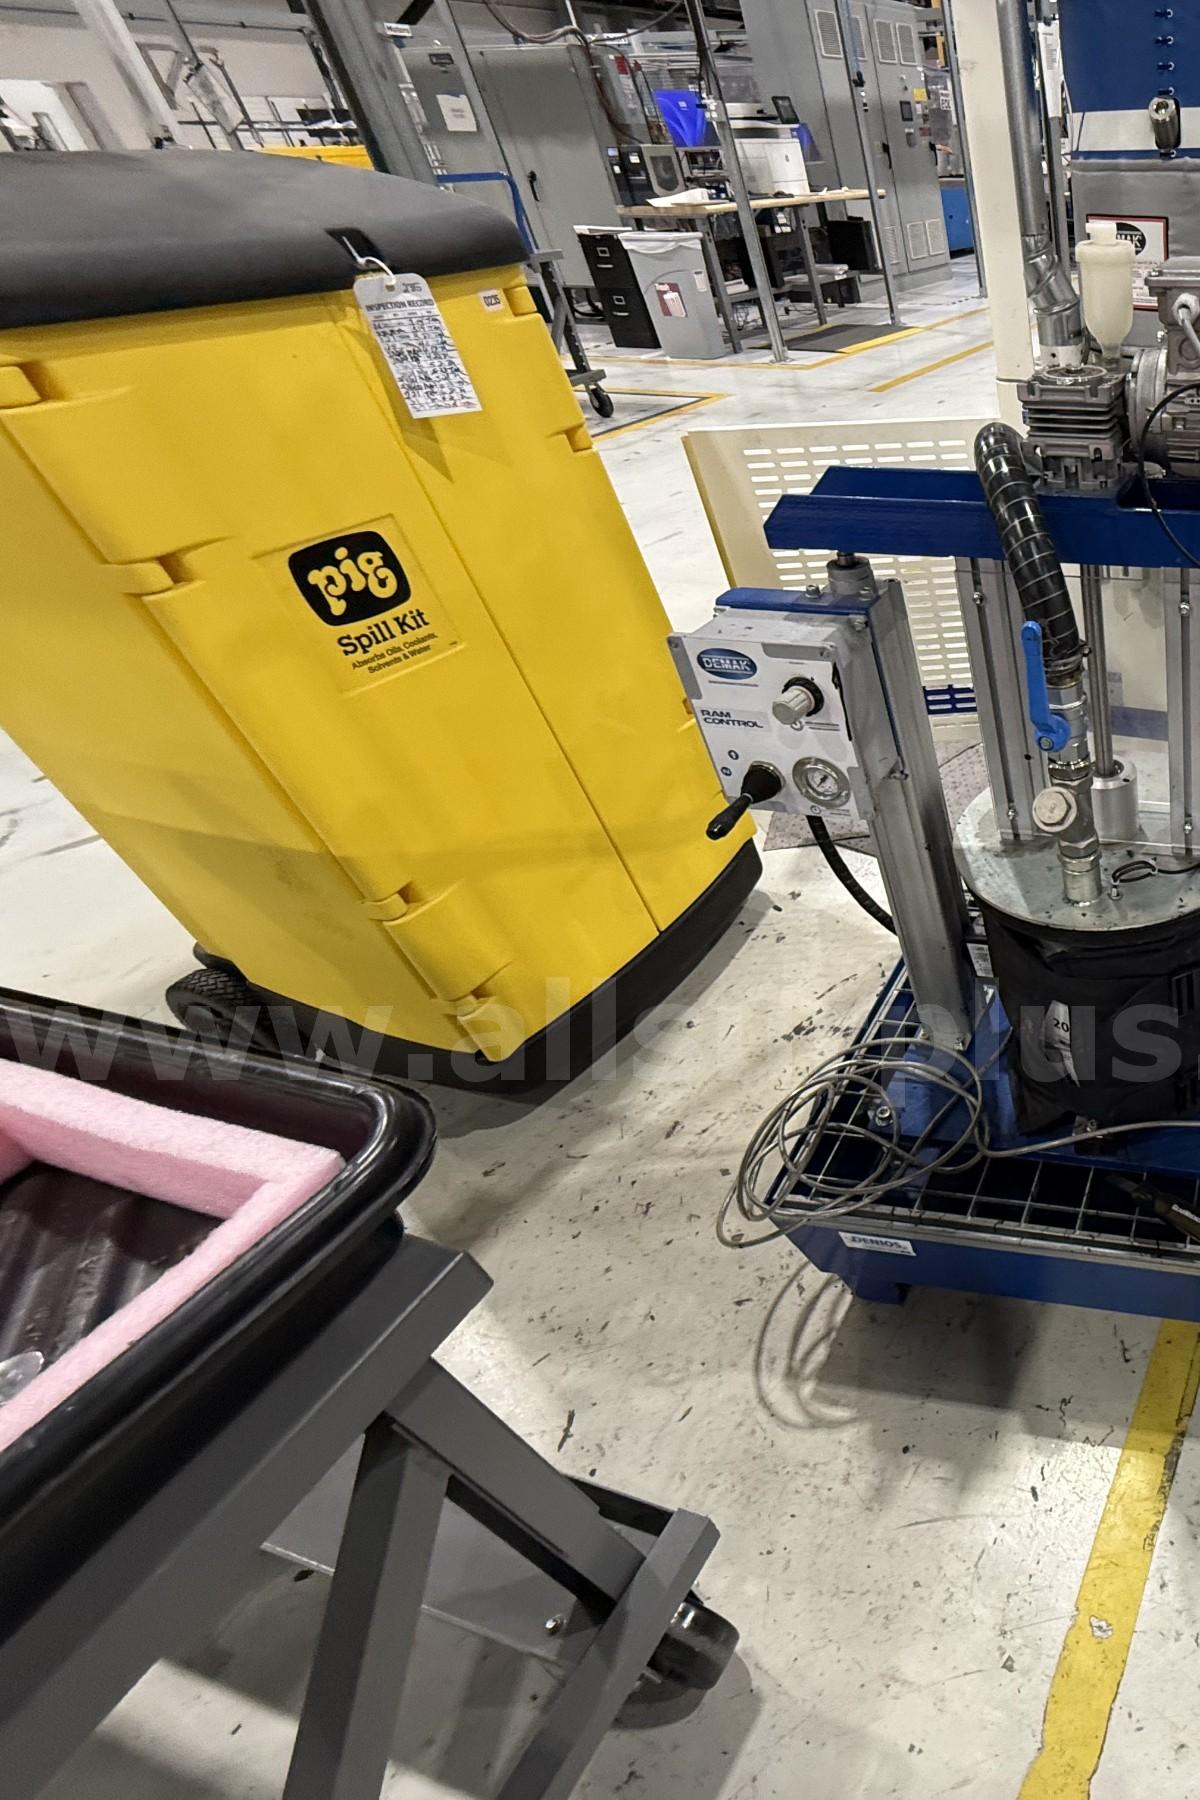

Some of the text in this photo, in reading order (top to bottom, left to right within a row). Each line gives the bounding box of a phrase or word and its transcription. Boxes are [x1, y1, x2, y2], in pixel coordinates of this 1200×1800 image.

[365, 301, 407, 312] INSPECTION
[307, 546, 398, 616] pig
[337, 608, 430, 656] Spill Kit
[703, 656, 751, 672] DEMAK
[701, 709, 732, 719] RAM
[703, 717, 764, 728] CONTROL
[1053, 1017, 1070, 1032] 20
